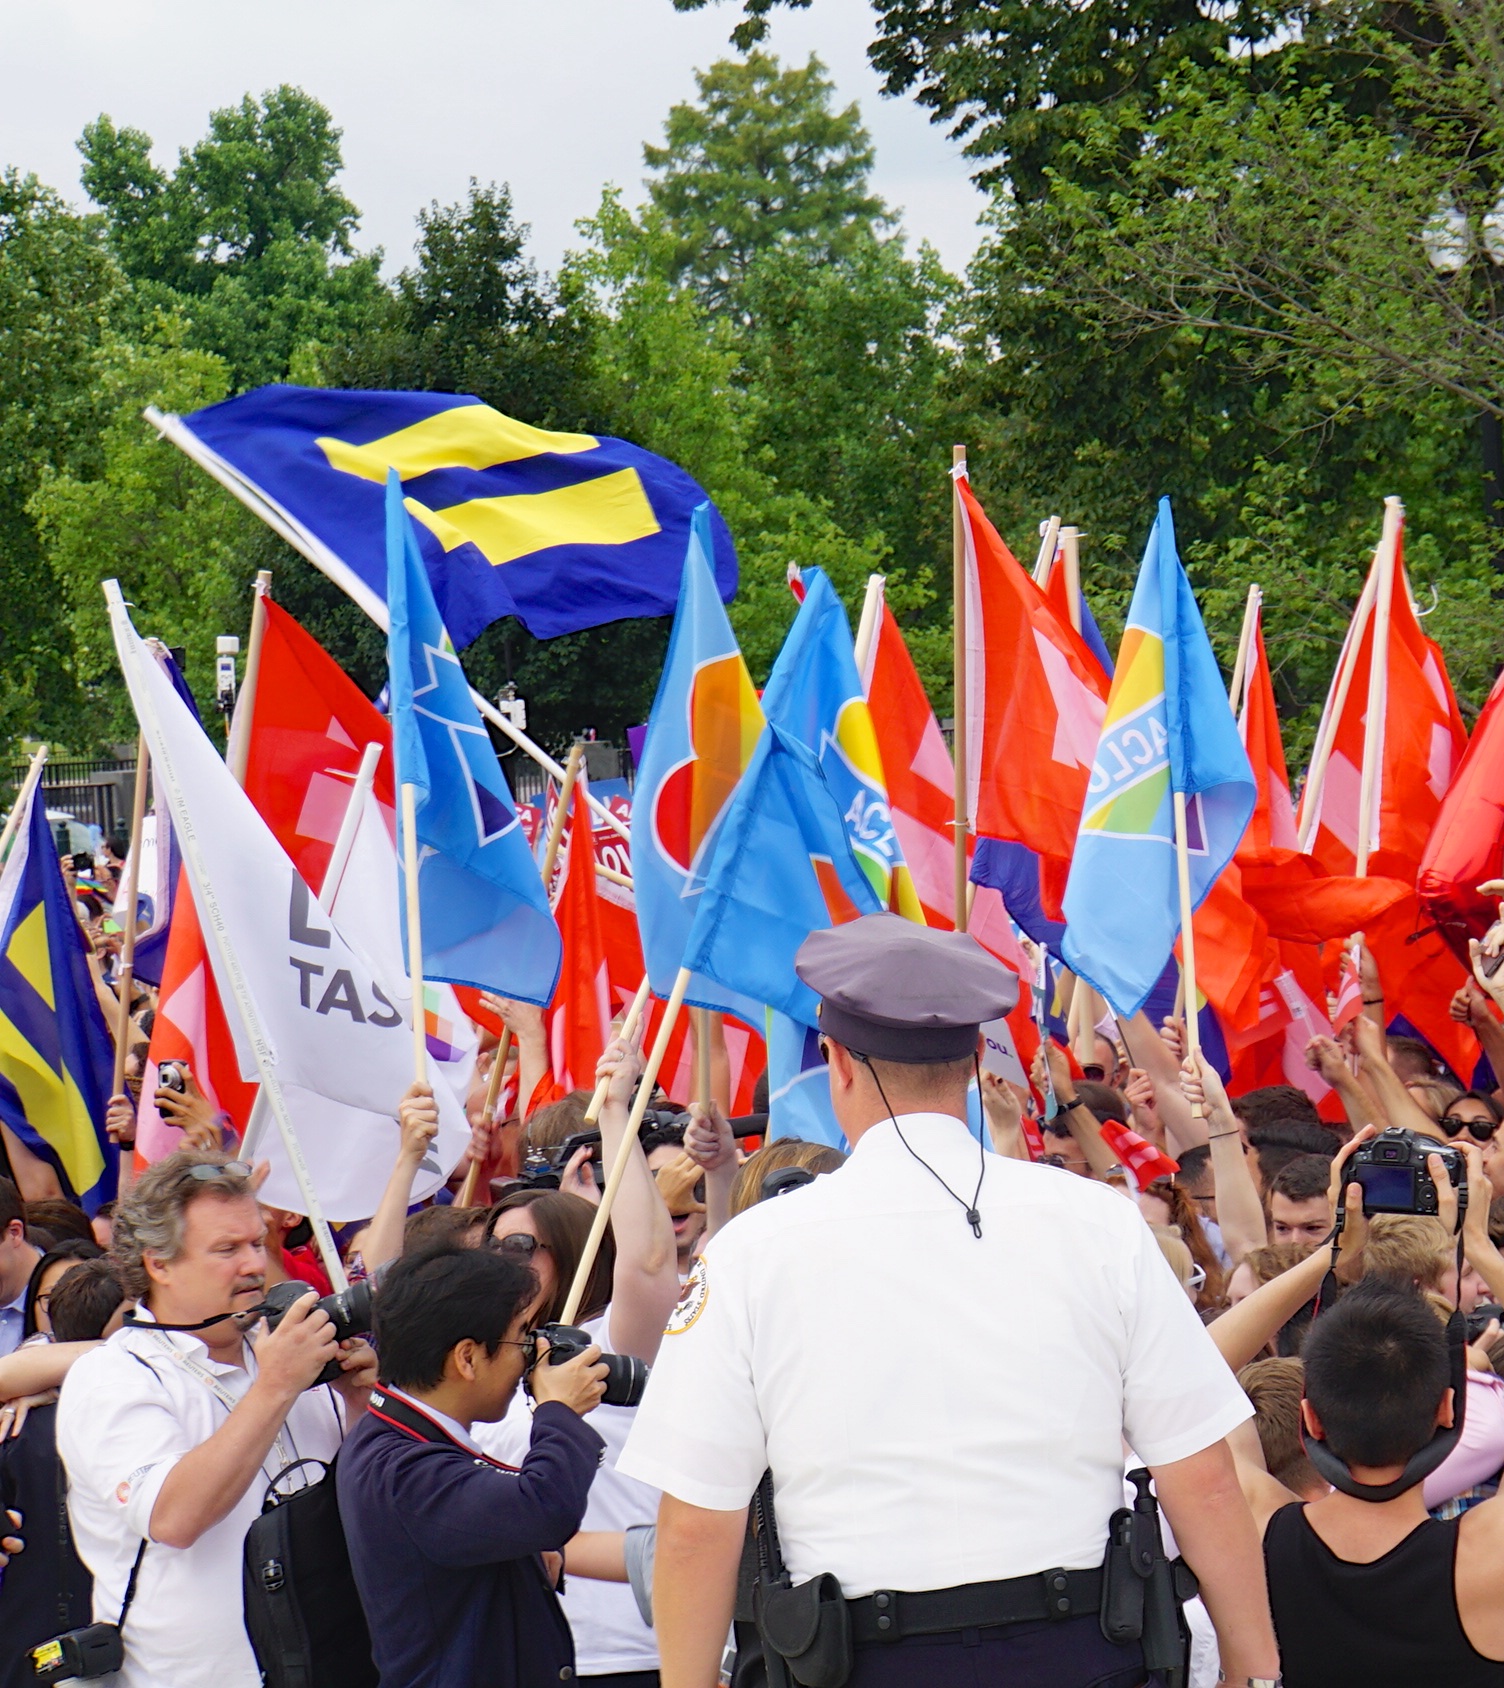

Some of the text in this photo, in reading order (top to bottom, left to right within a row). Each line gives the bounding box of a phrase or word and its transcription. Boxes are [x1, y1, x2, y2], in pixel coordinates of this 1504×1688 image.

[180, 810, 196, 841] EAGLE
[153, 1334, 236, 1404] REUTERS REUTERS REUTERS
